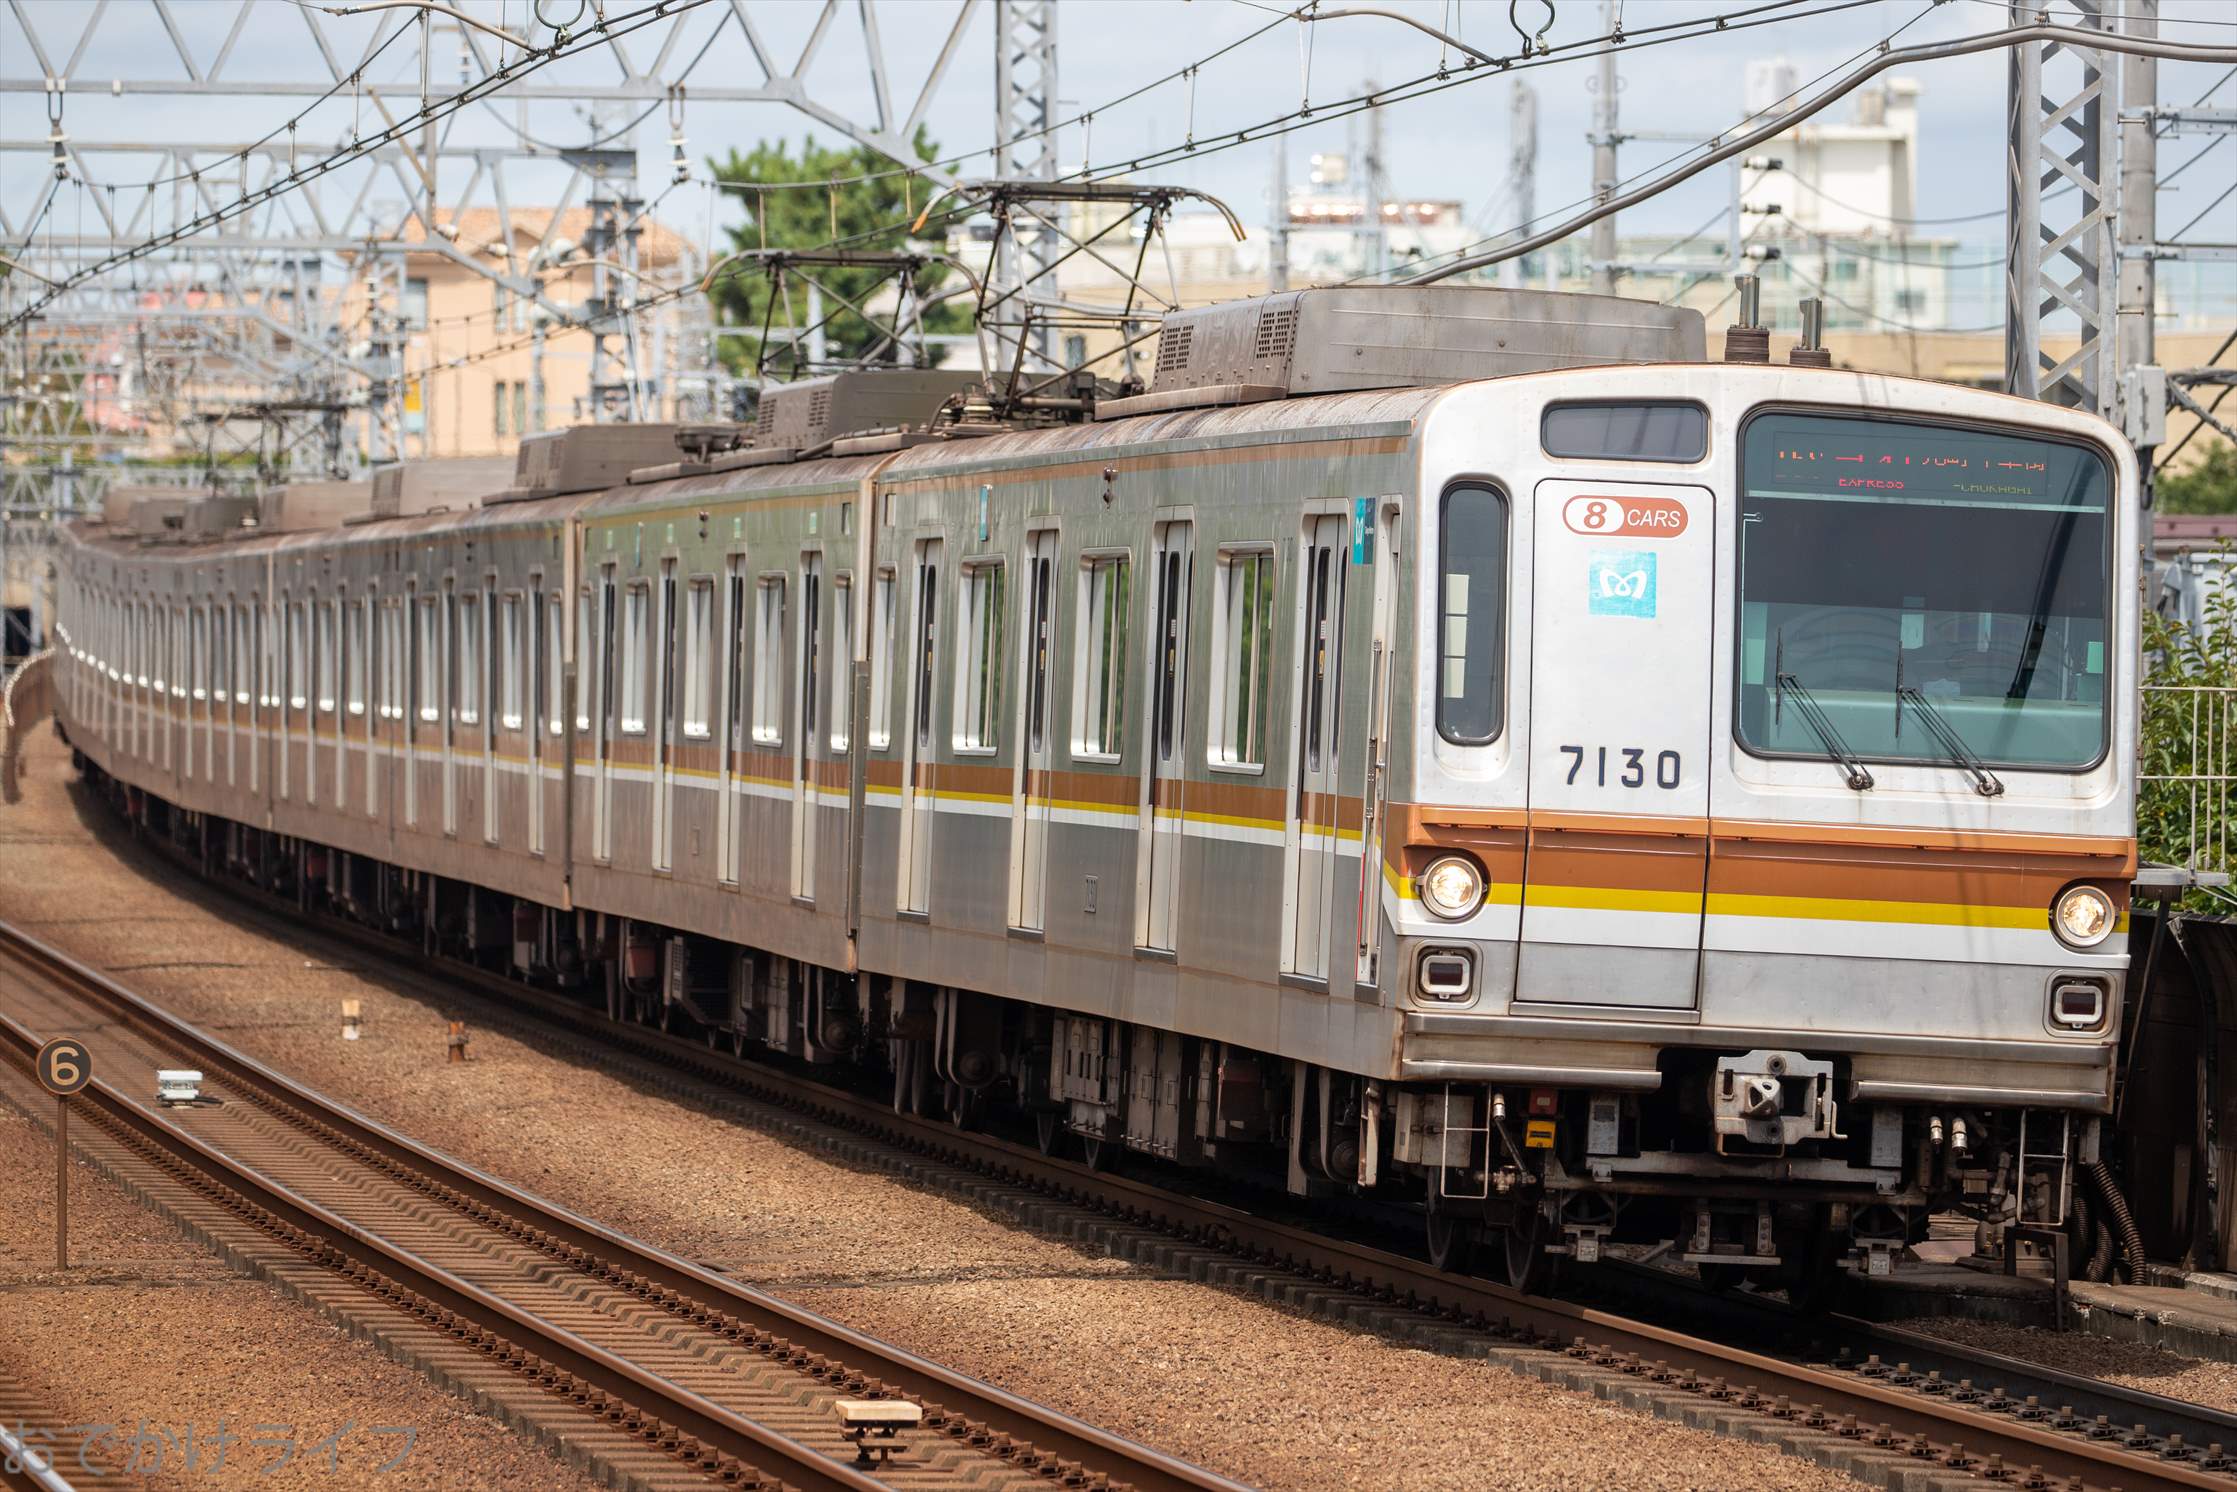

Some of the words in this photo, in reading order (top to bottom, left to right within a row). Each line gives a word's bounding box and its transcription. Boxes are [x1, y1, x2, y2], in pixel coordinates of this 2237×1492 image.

[1583, 501, 1607, 529] 8
[1626, 508, 1681, 528] CARS
[1559, 745, 1682, 790] 7130
[50, 1046, 80, 1086] 6
